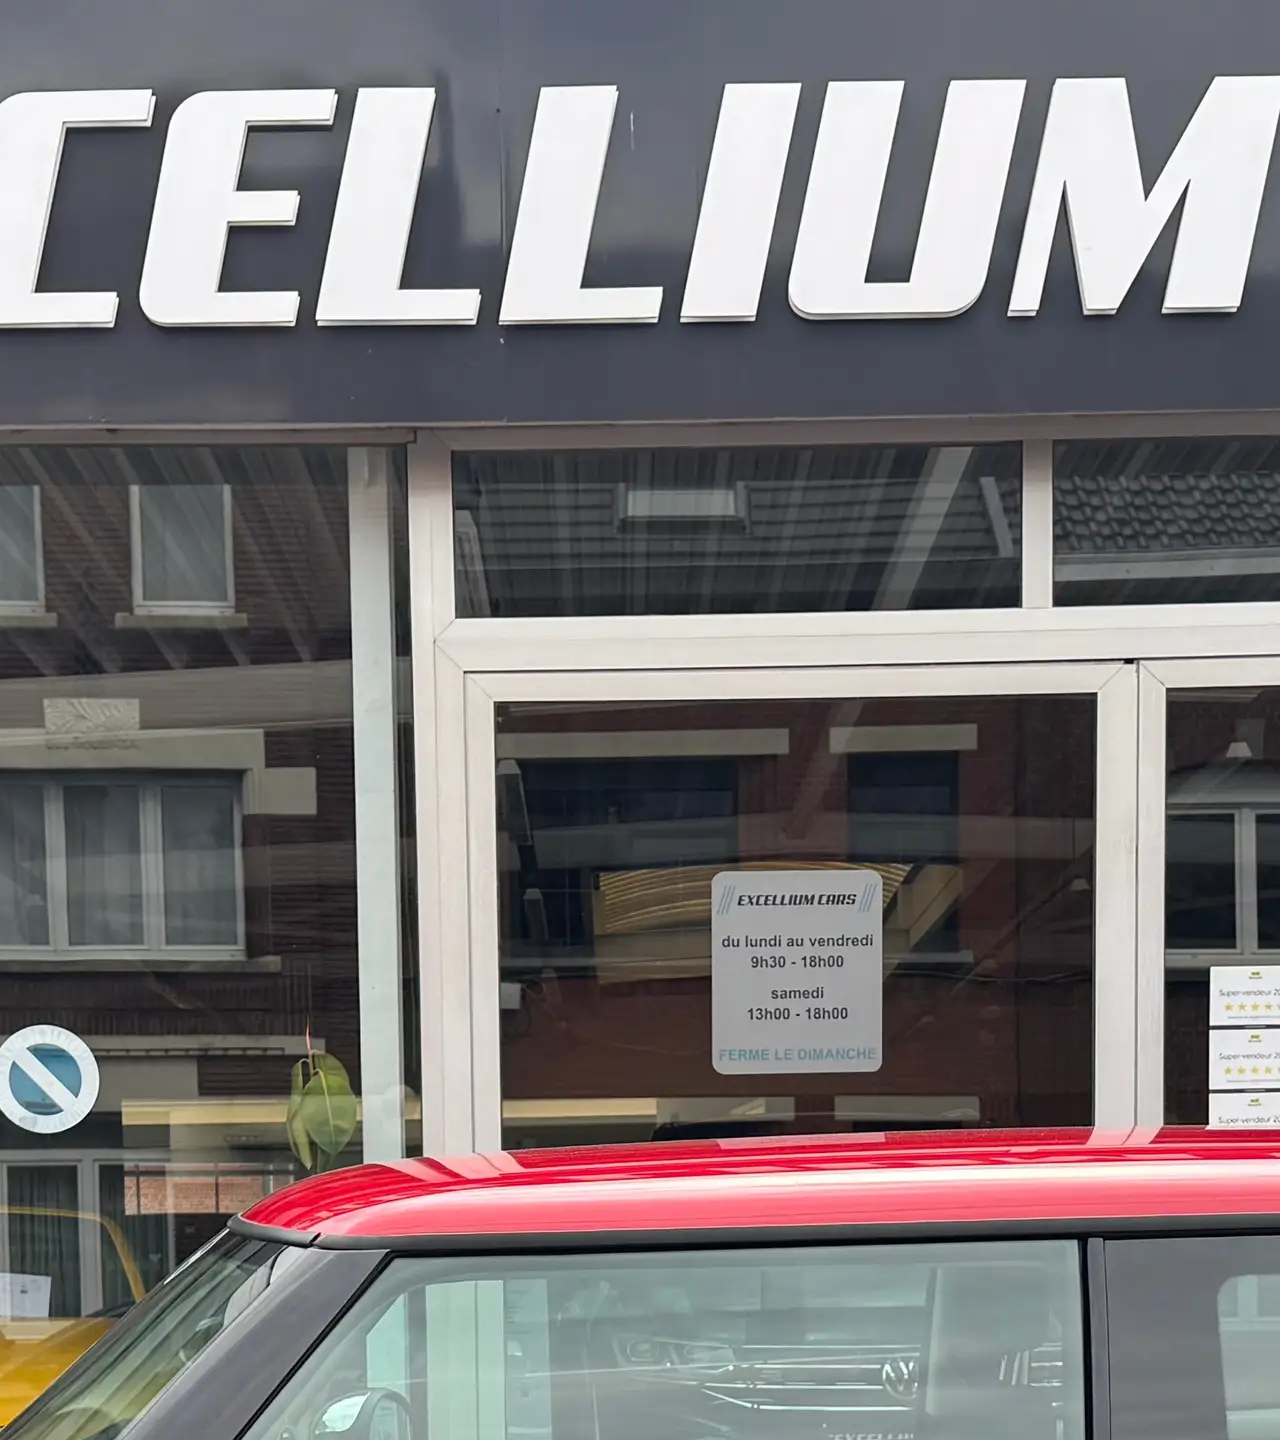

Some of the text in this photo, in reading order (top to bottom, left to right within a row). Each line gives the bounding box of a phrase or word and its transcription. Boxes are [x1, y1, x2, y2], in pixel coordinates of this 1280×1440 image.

[737, 894, 857, 906] EXCELLIUM CARS
[722, 934, 874, 947] du lundi au vendredi
[751, 955, 786, 969] 9h30
[801, 955, 844, 968] 18h00
[771, 986, 824, 1000] samedi
[747, 1007, 790, 1020] 13h00
[805, 1007, 848, 1020] 18h00
[719, 1047, 877, 1062] FERME LE DIMANCHE
